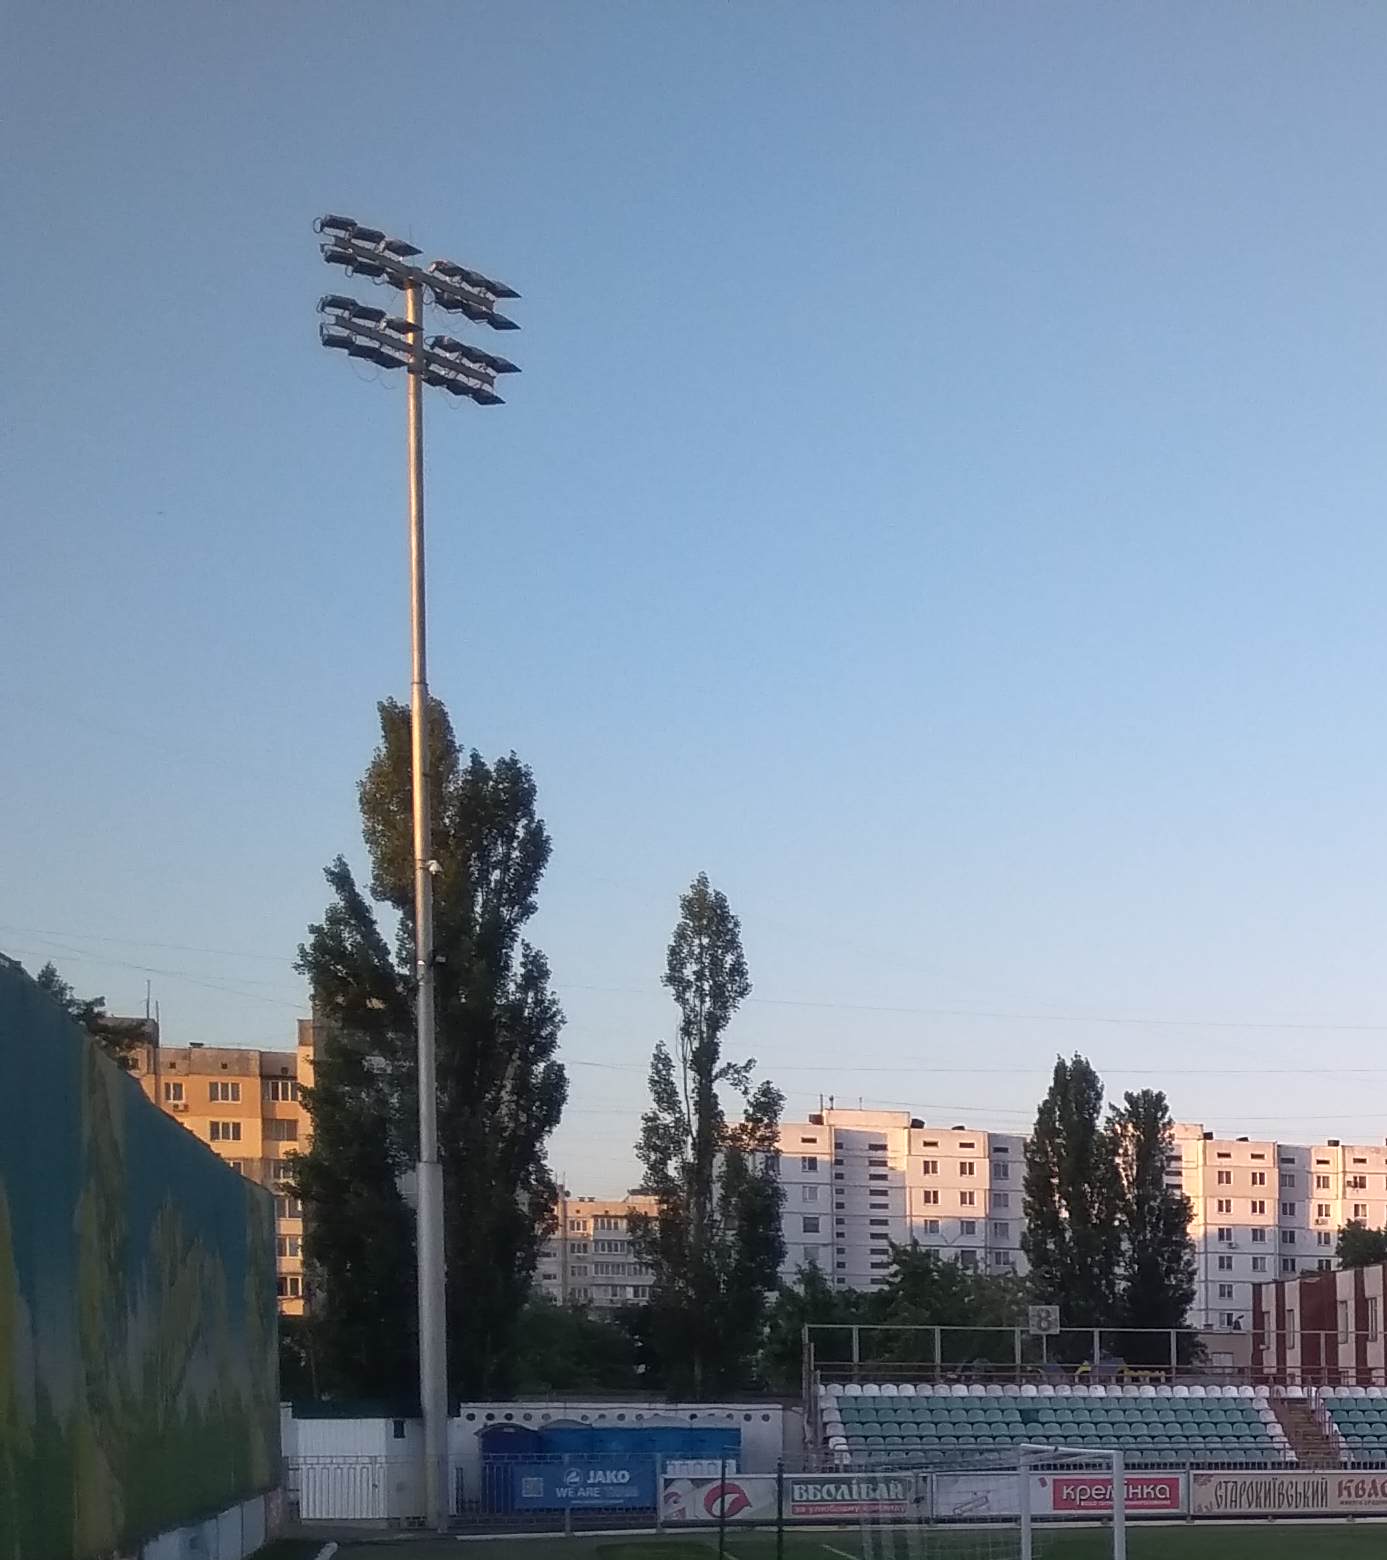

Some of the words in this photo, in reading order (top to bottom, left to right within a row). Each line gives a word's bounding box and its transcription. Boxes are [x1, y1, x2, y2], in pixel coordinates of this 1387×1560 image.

[587, 1470, 630, 1484] JAKO
[556, 1487, 574, 1498] WE
[577, 1487, 600, 1497] ARE
[1215, 1477, 1328, 1509] СТАРОКИЇВСЬКИЙ
